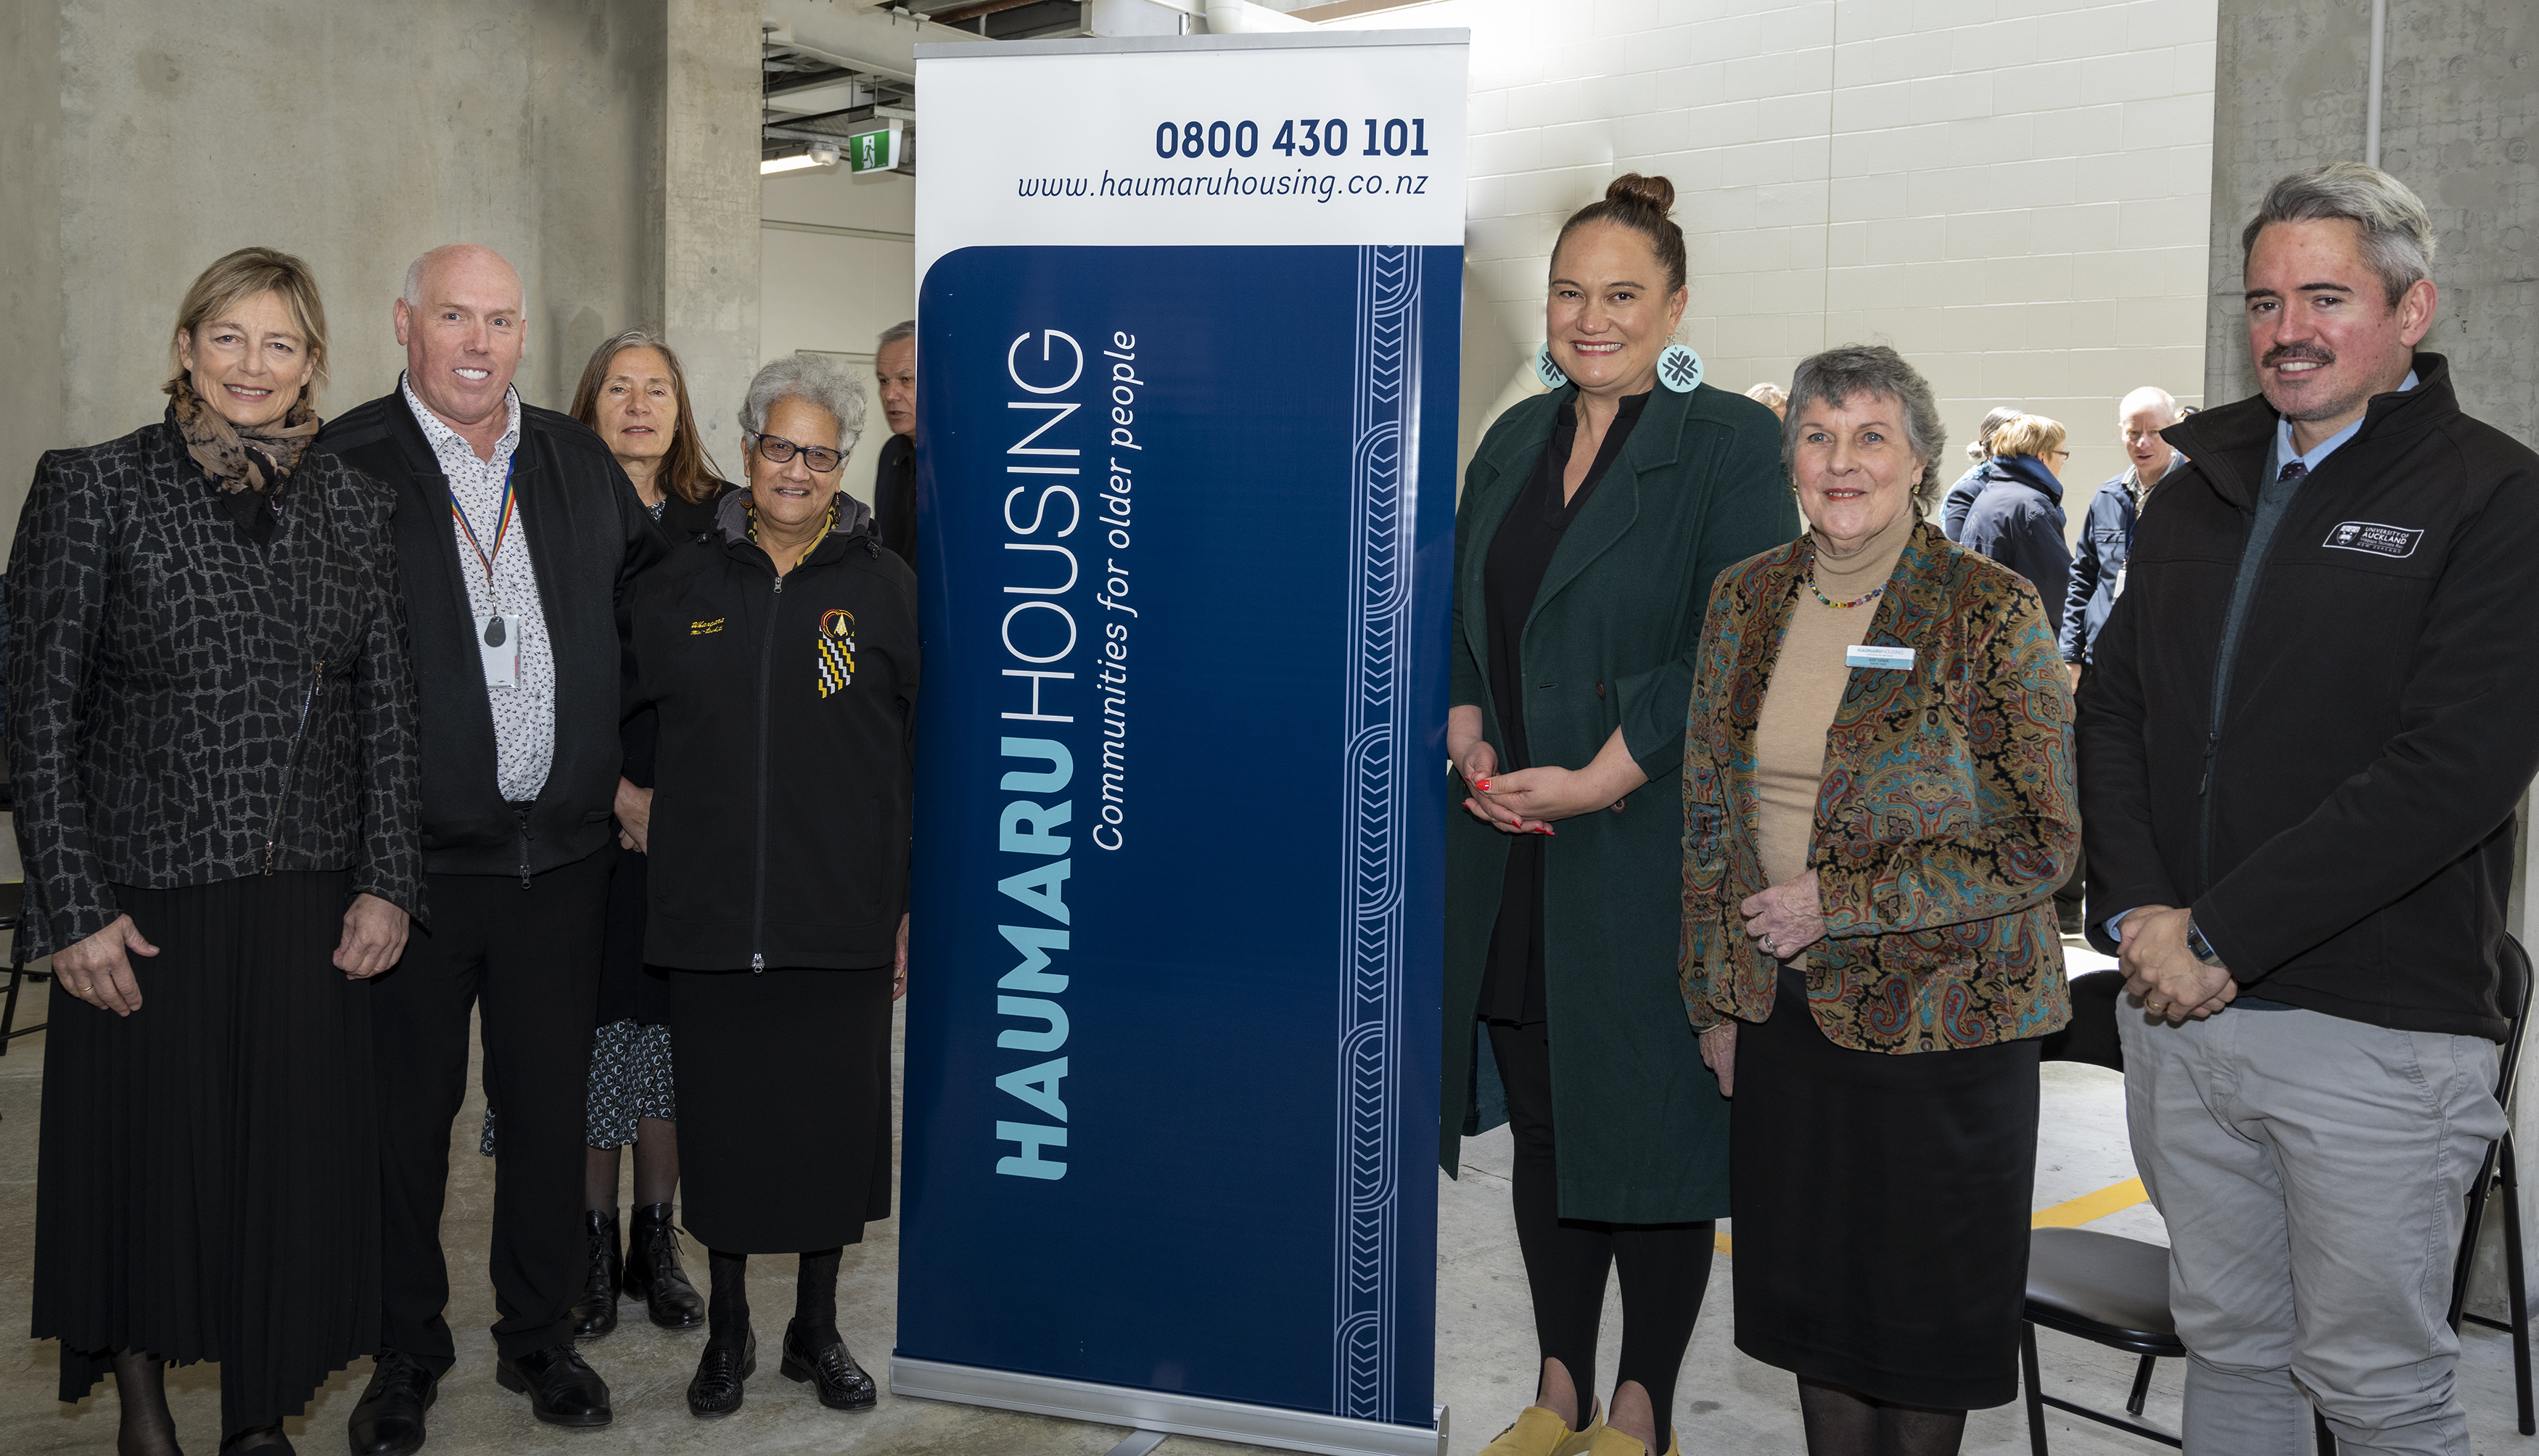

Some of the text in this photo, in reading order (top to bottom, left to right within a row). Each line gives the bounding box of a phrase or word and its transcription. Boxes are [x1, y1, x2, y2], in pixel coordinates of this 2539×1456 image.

[1156, 118, 1428, 159] 0800 430 101
[1018, 168, 1429, 204] www.haumaruhousing.co.nz
[2362, 532, 2407, 545] AUCKLAND
[2365, 527, 2401, 537] UNIVERSITY
[1092, 331, 1144, 851] Communities for older people
